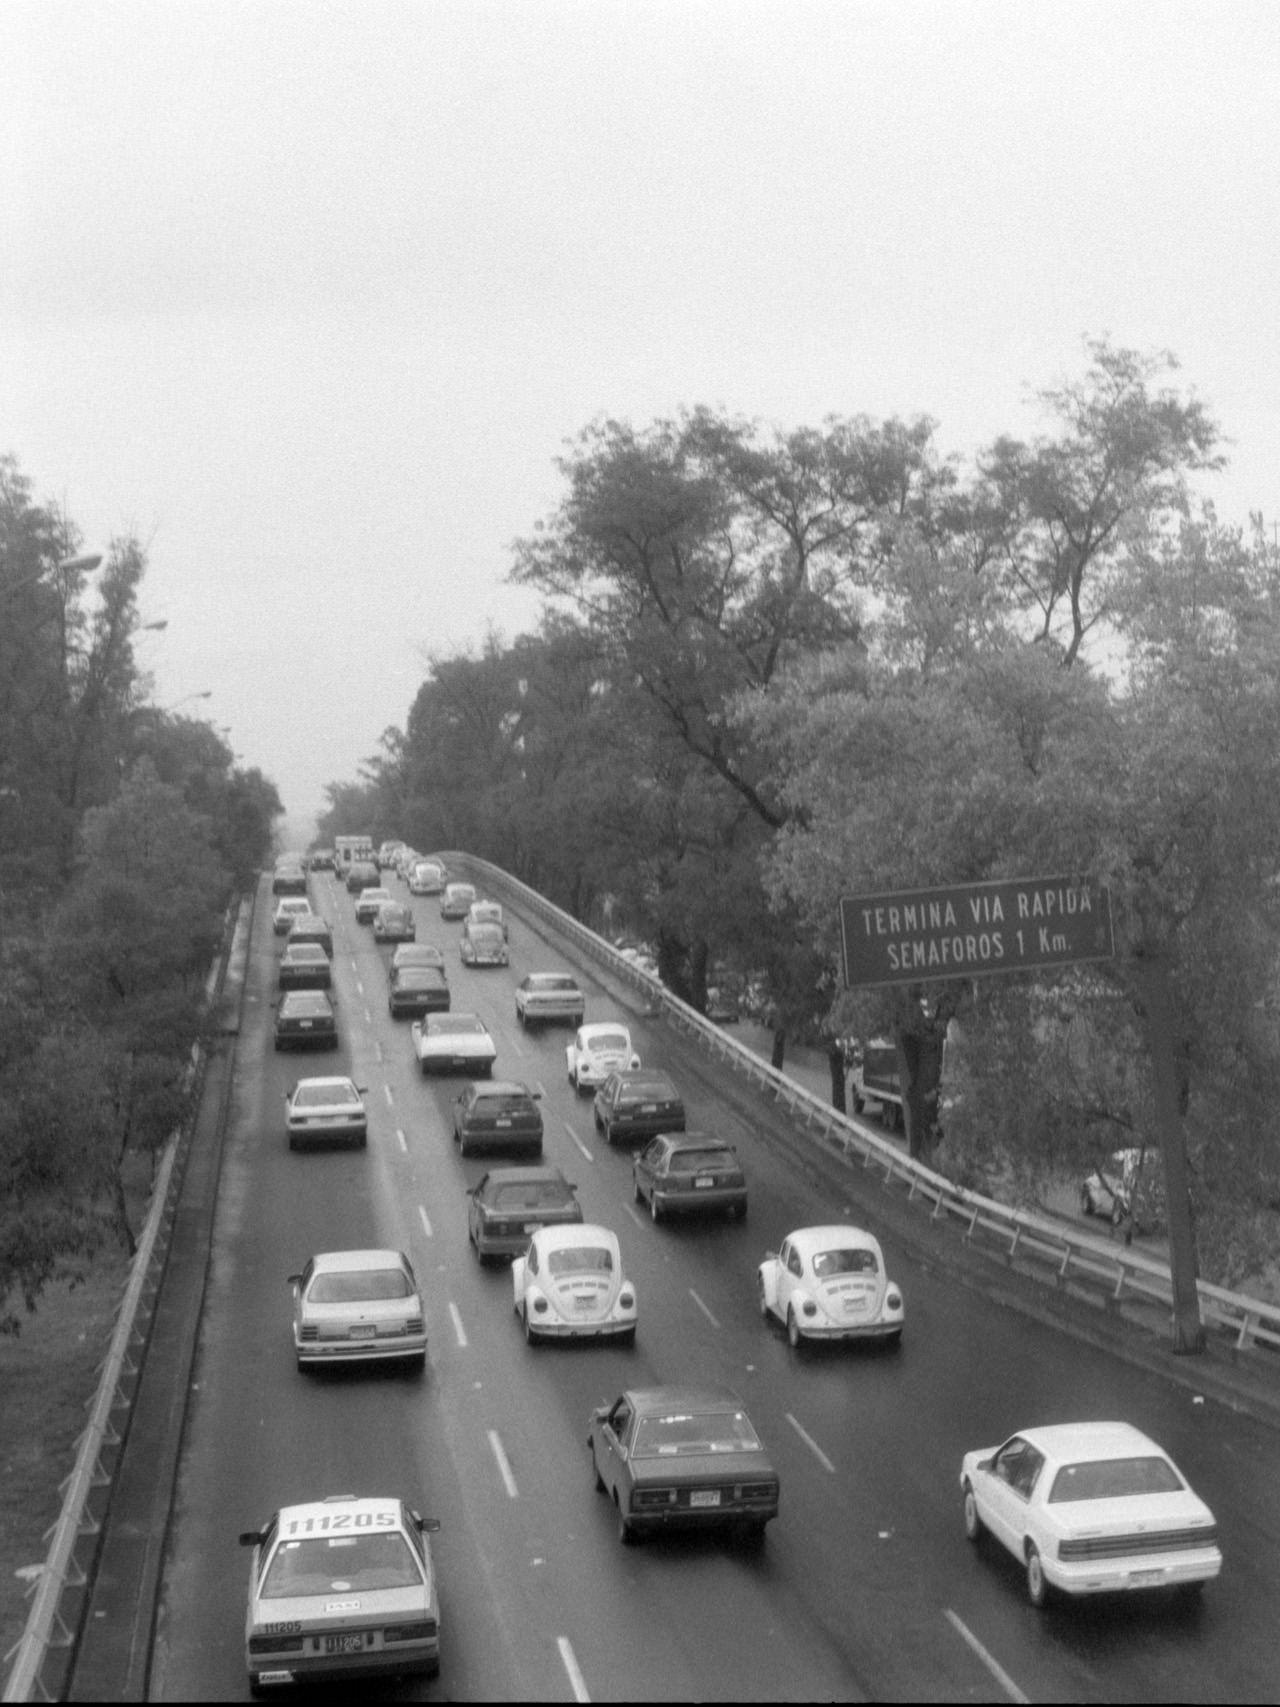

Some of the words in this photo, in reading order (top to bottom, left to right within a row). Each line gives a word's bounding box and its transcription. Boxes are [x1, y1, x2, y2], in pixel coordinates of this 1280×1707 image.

[862, 900, 957, 936] TERMINA
[969, 895, 1005, 924] VIA
[1017, 886, 1093, 919] RAPIDA
[887, 933, 1005, 970] SEMAFOROS
[1016, 930, 1026, 955] 1
[287, 1512, 396, 1535] 111205
[264, 1621, 302, 1633] 111205
